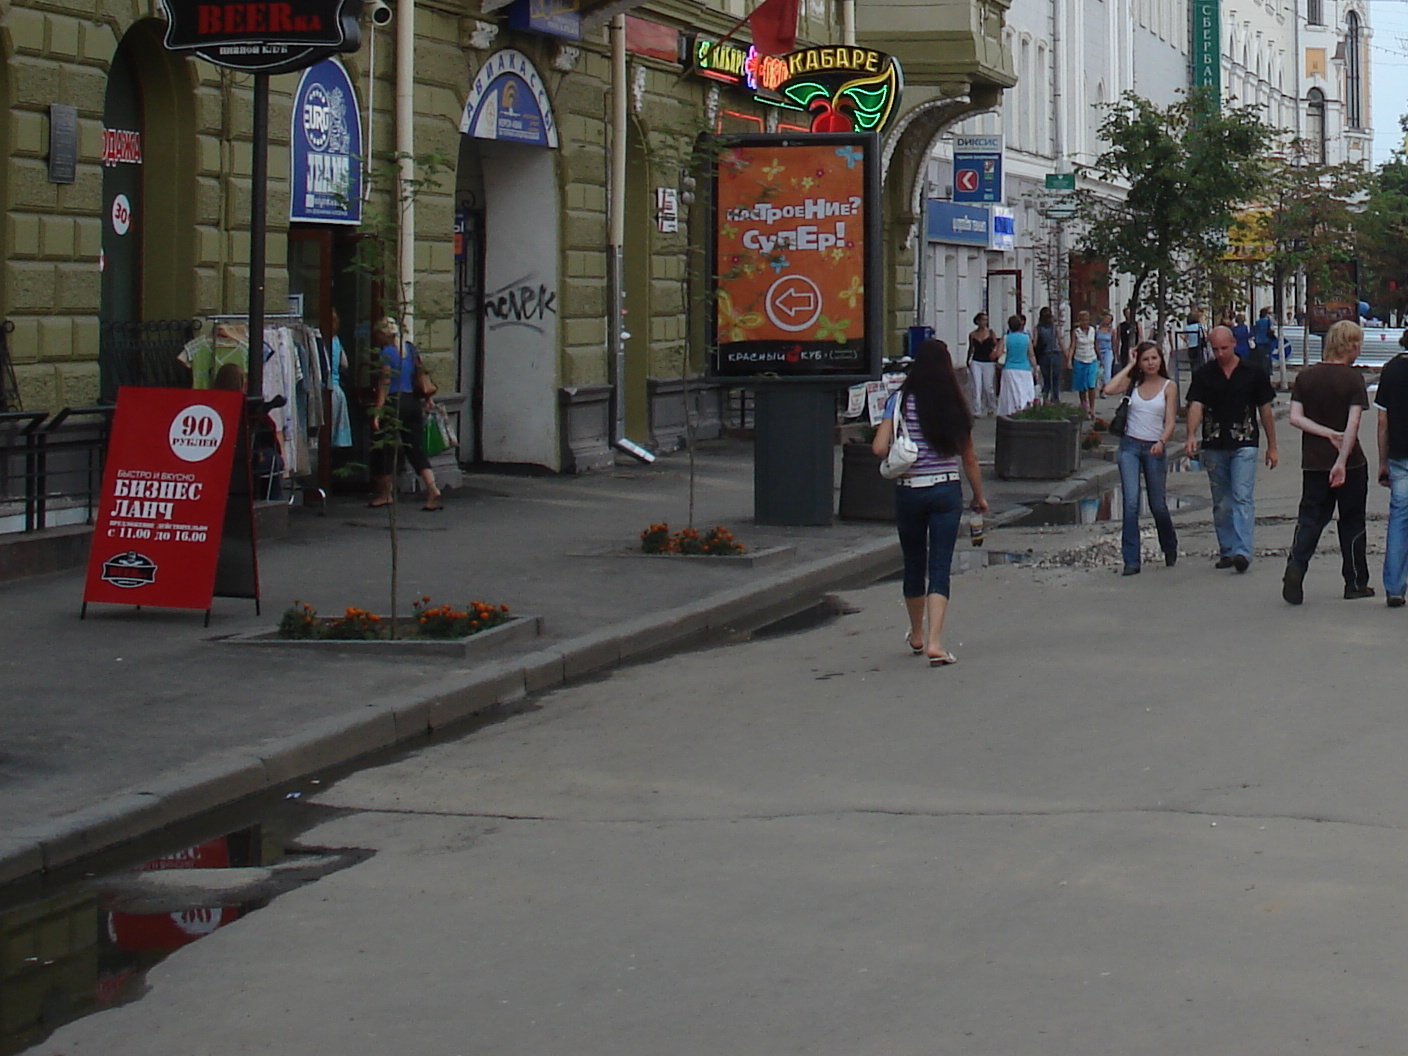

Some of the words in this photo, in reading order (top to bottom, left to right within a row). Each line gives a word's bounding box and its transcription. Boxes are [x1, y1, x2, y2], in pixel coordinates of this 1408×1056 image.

[789, 48, 879, 74] КАБАРЕ
[1202, 5, 1214, 98] СБЕРБАН
[466, 53, 554, 131] АВИАКАССЫ
[304, 104, 331, 133] EURO
[306, 152, 349, 194] JEANS
[182, 416, 213, 436] 90
[172, 437, 218, 448] РУБЛЕЙ
[117, 469, 151, 480] БЫСТРО
[153, 471, 160, 480] И
[161, 472, 195, 481] ВКУСНО
[114, 479, 203, 500] БИЗНЕС
[110, 499, 174, 520] ЛАНЧ
[119, 528, 151, 540] 11.00
[154, 531, 171, 541] до
[175, 531, 206, 542] 16.00
